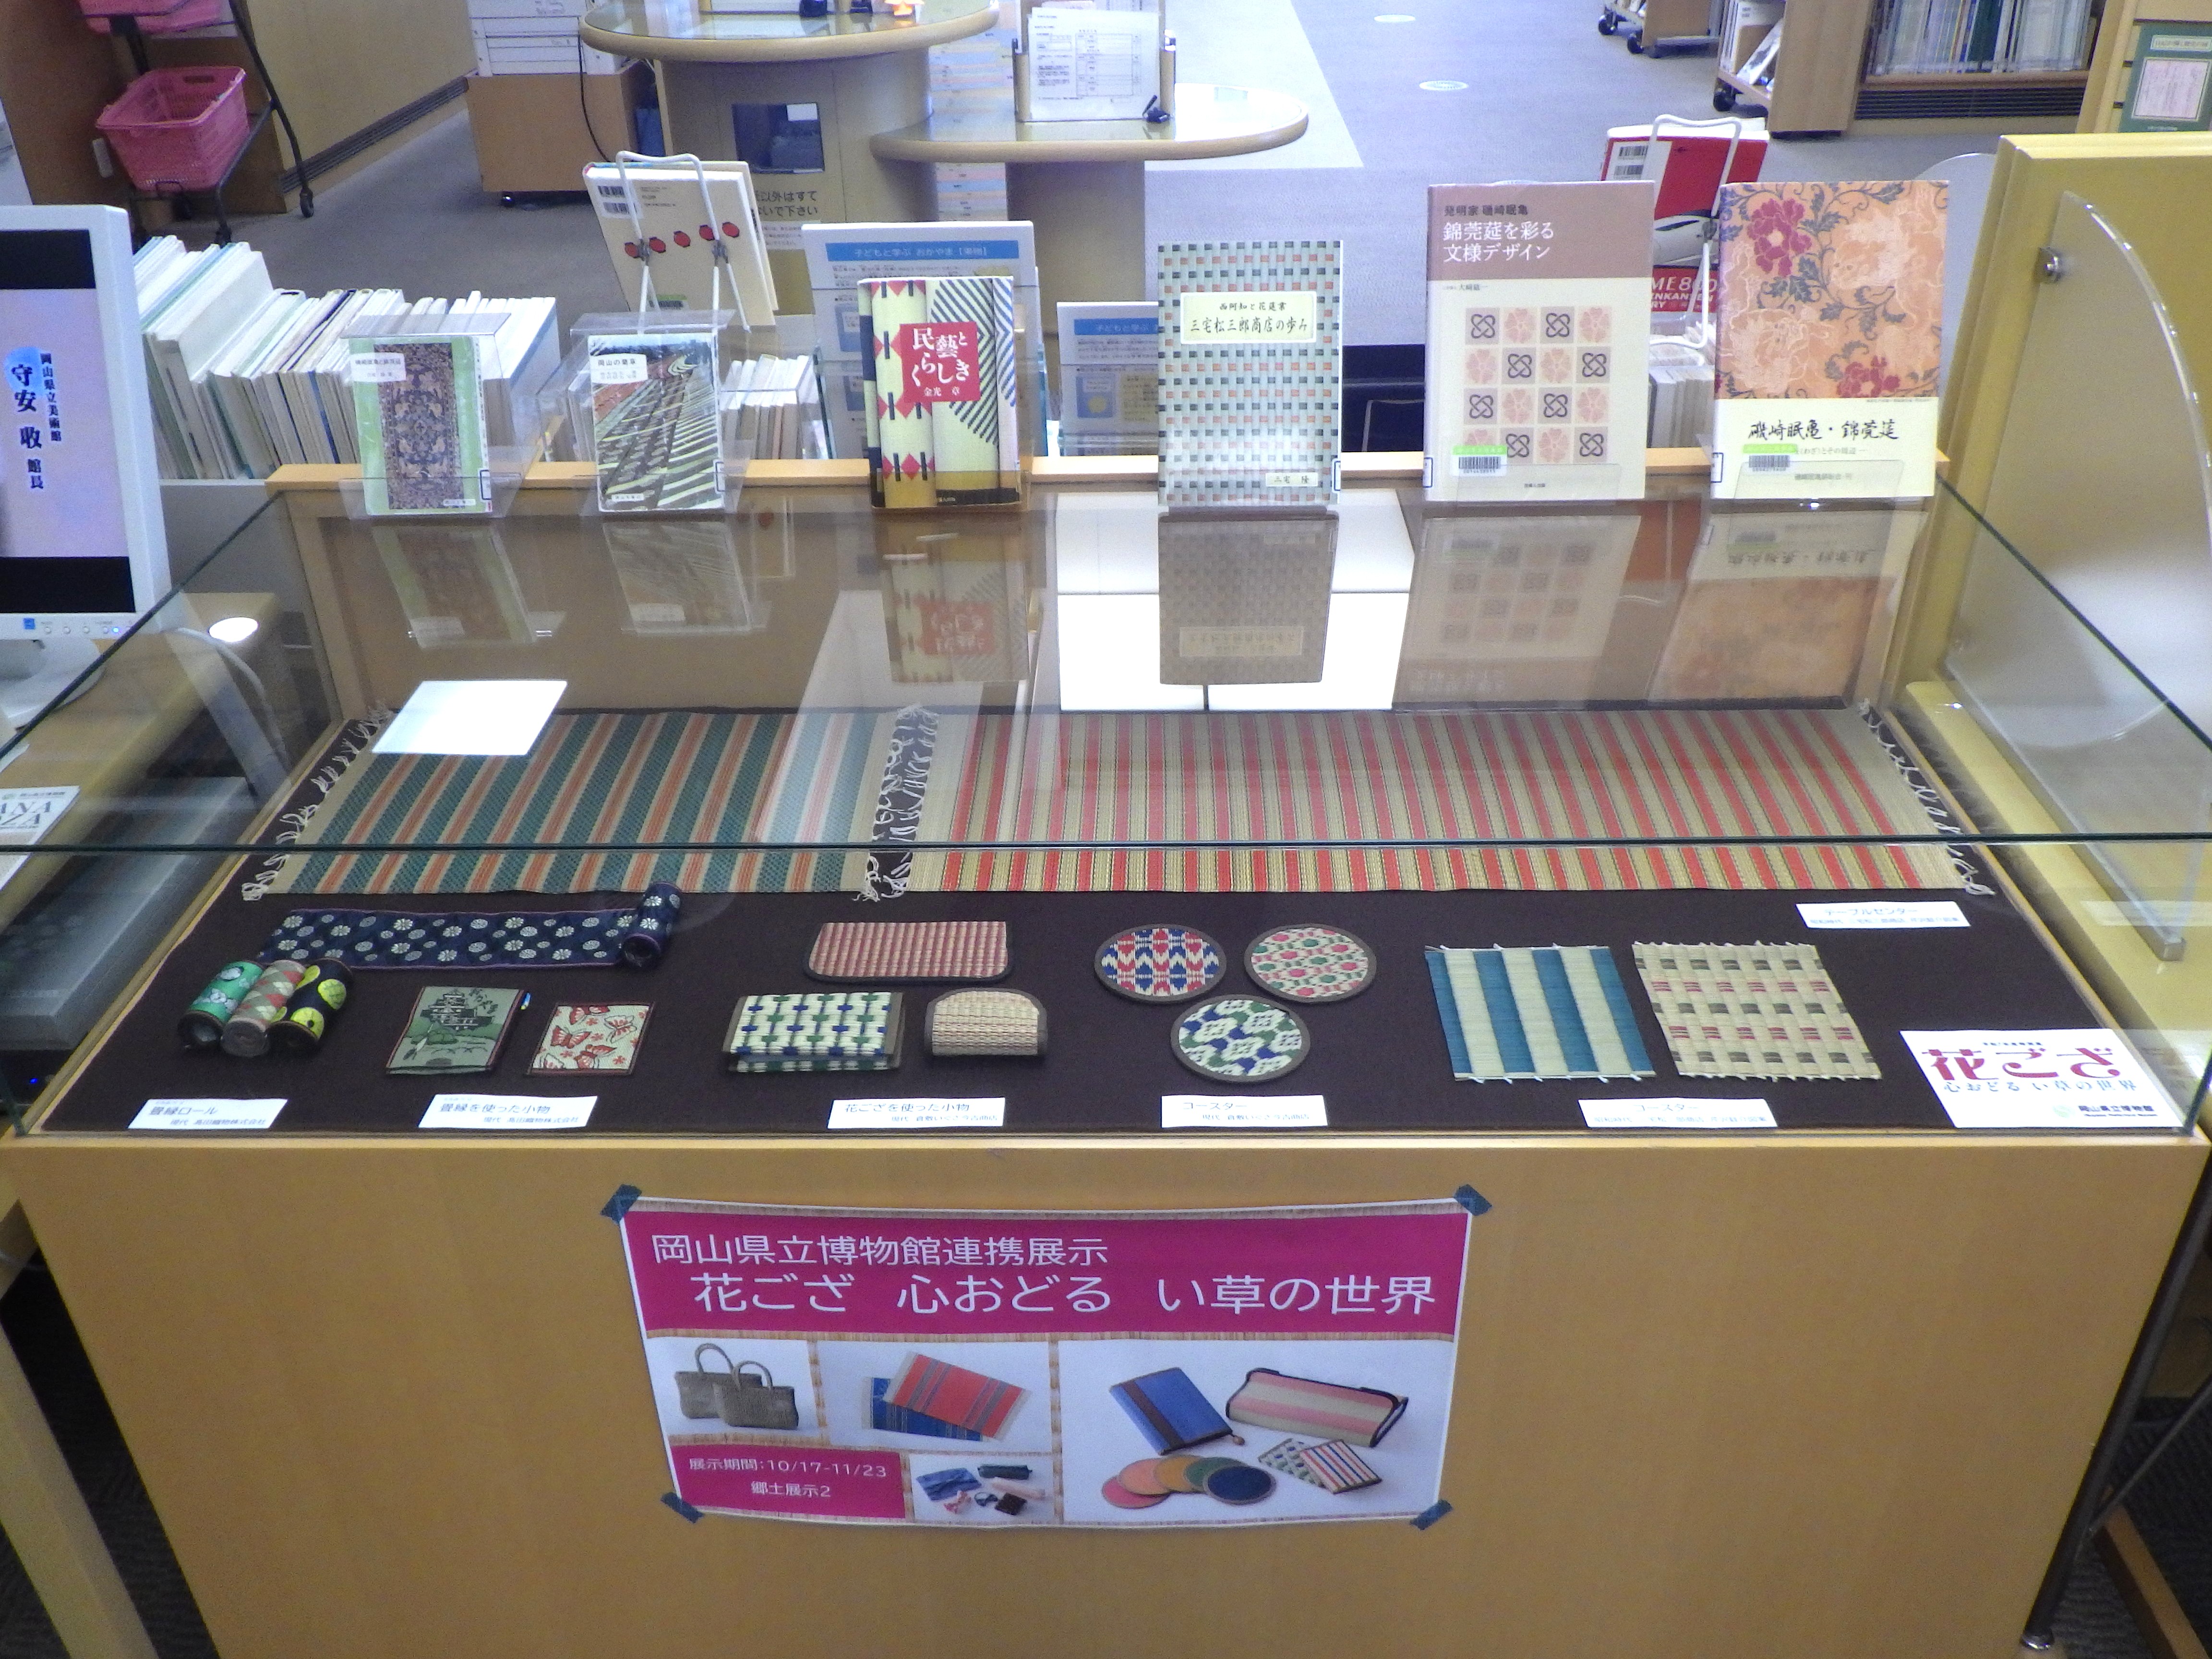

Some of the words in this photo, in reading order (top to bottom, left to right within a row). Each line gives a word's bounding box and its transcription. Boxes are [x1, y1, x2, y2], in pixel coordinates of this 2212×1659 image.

[1443, 243, 1551, 263] 文様デザイン
[1190, 316, 1308, 334] 三宅松三郎商店の歩み
[11, 363, 36, 412] 守安
[1921, 1047, 2121, 1081] 花ござ
[1944, 1080, 2020, 1093] 心おどる
[2032, 1079, 2137, 1092] い草の世界
[439, 1103, 551, 1114] 畳縁を使った小物
[844, 1103, 970, 1113] 花ござを使った小物
[1183, 1102, 1248, 1110] コースター
[1633, 1103, 1699, 1112] コースター
[651, 1234, 1108, 1266] 岡山県立博物館連携展示
[690, 1272, 854, 1312] 花ござ
[897, 1274, 1111, 1314] 心おどる
[1157, 1274, 1435, 1315] い草の世界
[751, 1480, 831, 1498] 郷土展示2
